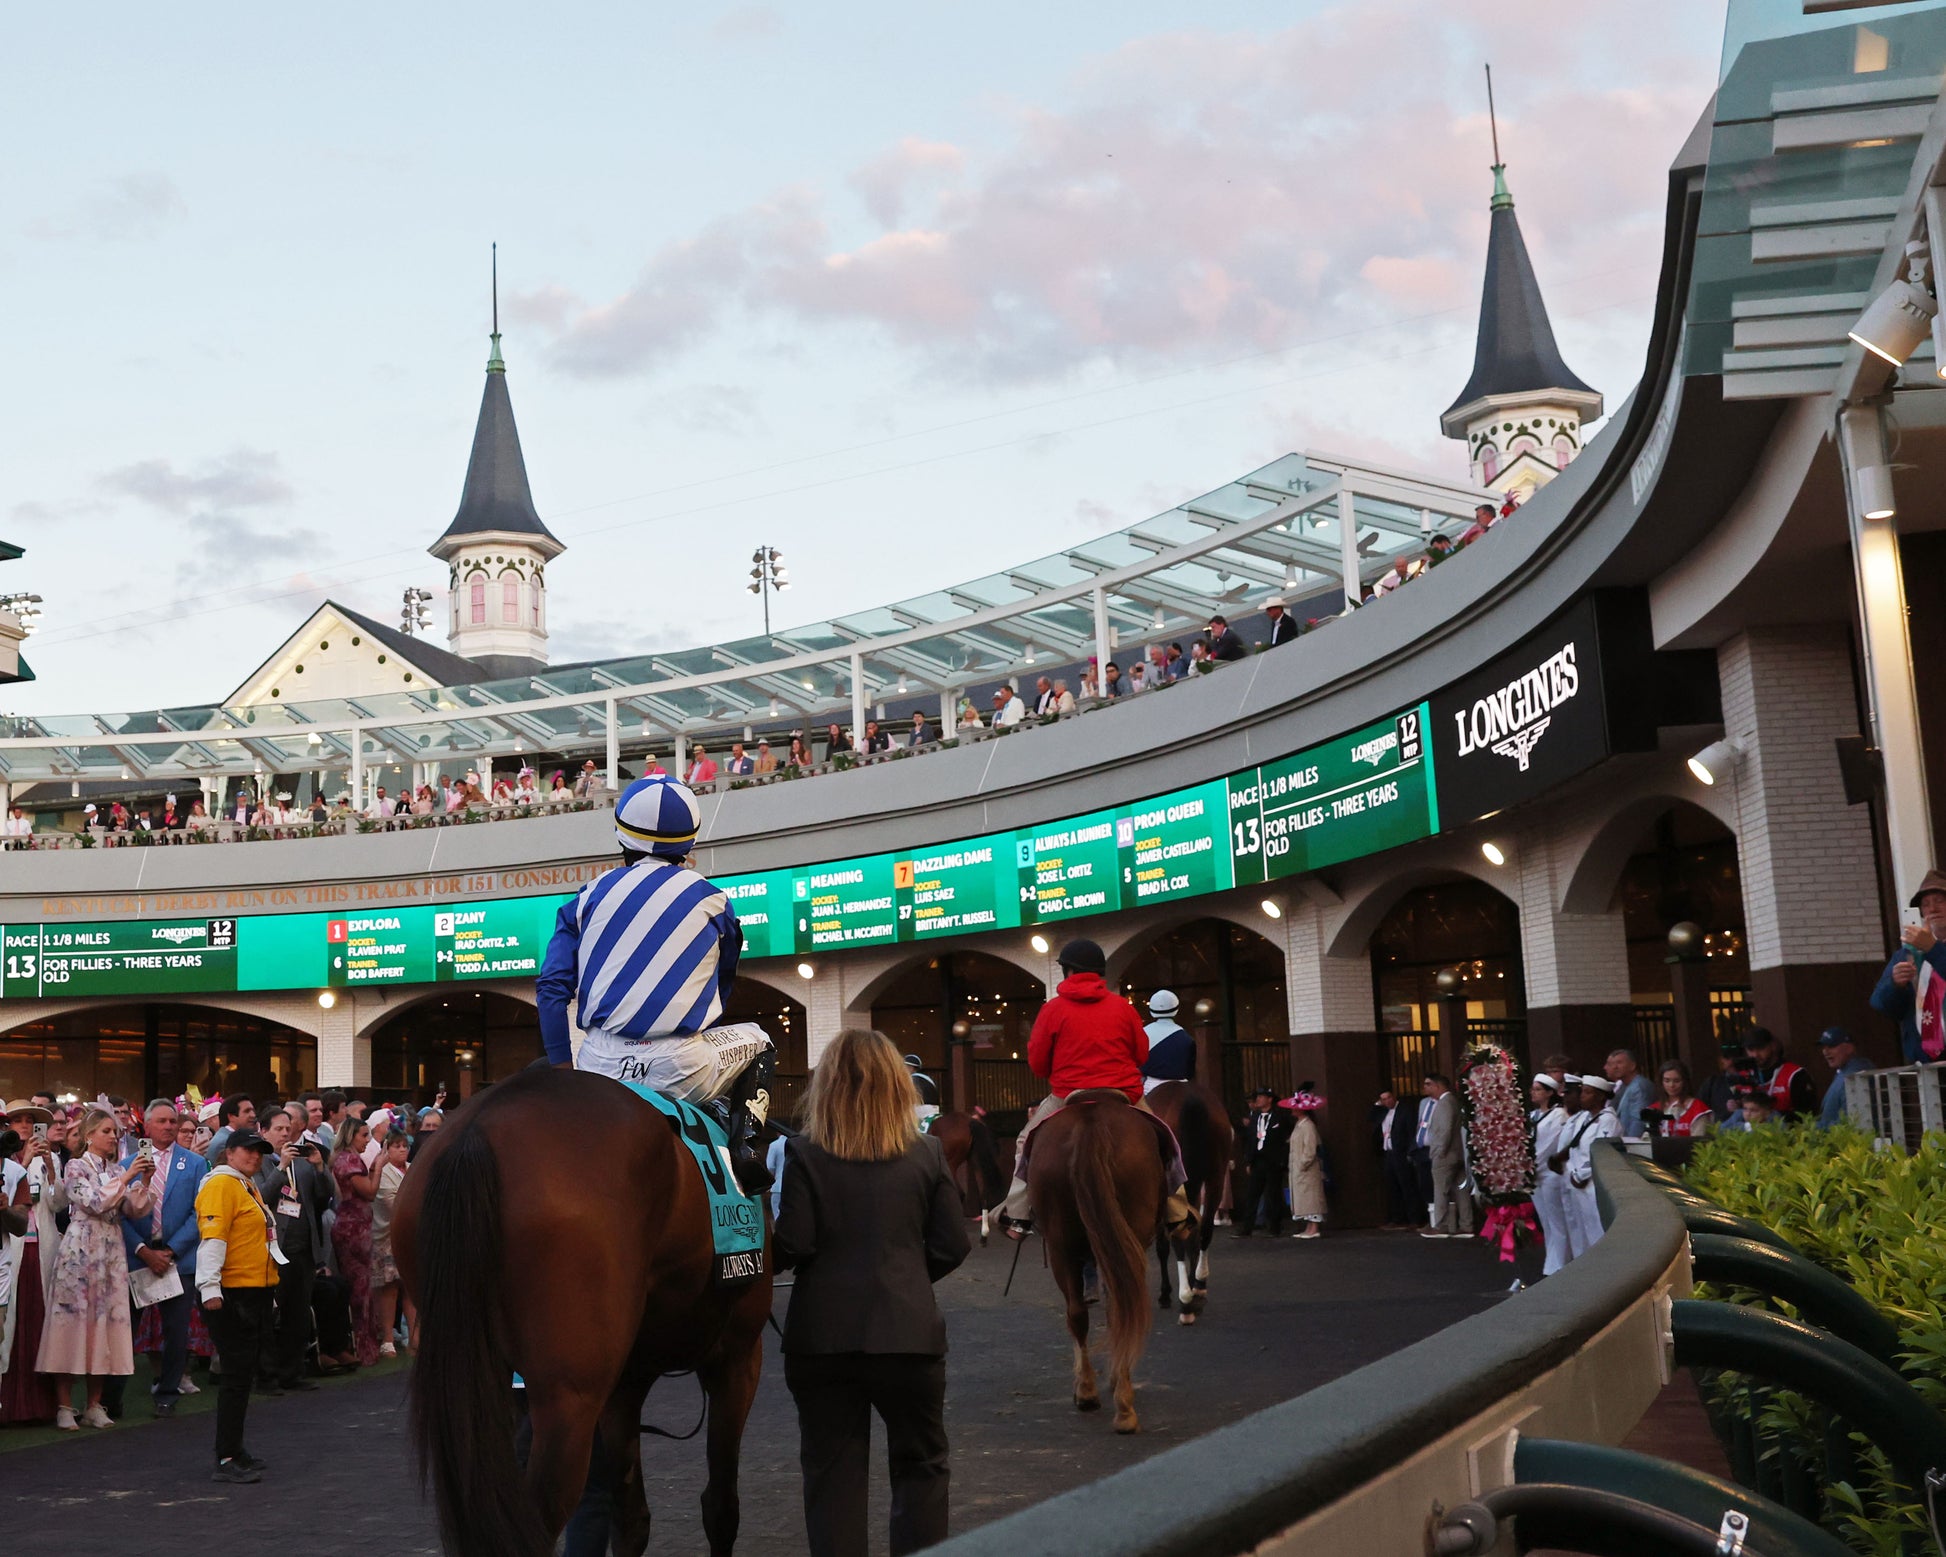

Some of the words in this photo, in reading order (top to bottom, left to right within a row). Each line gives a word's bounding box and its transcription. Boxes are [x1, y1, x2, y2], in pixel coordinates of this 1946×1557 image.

[1455, 642, 1578, 756] LONGINES
[1400, 714, 1418, 743] 12
[1351, 732, 1398, 763] LONGINES
[1404, 742, 1418, 759] MTP
[1262, 782, 1270, 799] 1
[1271, 778, 1287, 796] 1/8
[1288, 766, 1319, 791] MILES
[1230, 786, 1258, 810] RACE
[1134, 810, 1166, 831] PROM
[1167, 799, 1204, 822] QUEEN
[1265, 820, 1288, 839] FOR
[1288, 806, 1324, 832] FILLIES
[1331, 796, 1366, 820] THREE
[1366, 782, 1398, 808] YEARS
[1035, 832, 1070, 852] ALWAYS
[1070, 831, 1077, 845] A
[1077, 823, 1112, 843] RUNNER
[1118, 822, 1132, 842] 10
[1234, 818, 1260, 856] 13
[1136, 836, 1162, 851] JOCKEY:
[1136, 848, 1163, 865] JAVIER
[1163, 836, 1212, 859] CASTELLANO
[1266, 836, 1290, 858] OLD
[914, 853, 962, 874] DAZZLING
[964, 848, 992, 866] DAME
[1022, 846, 1029, 861] 9
[1036, 858, 1063, 872] JOCKEY:
[810, 870, 863, 889] MEANING
[900, 867, 907, 882] 7
[1037, 869, 1058, 884] JOSE
[1059, 868, 1066, 880] L.
[1067, 863, 1092, 879] ORTIZ
[1124, 867, 1132, 883] 5
[1136, 868, 1165, 882] TRAINER:
[738, 883, 767, 898] STARS
[796, 881, 806, 898] 5
[914, 880, 941, 892] JOCKEY:
[1138, 880, 1160, 897] BRAD
[1161, 879, 1170, 892] H.
[1170, 874, 1190, 890] COX
[42, 896, 148, 915] KENTUCKY
[154, 892, 220, 912] DERBY
[226, 890, 264, 908] RUN
[270, 888, 298, 906] ON
[304, 885, 349, 904] THIS
[356, 881, 418, 900] TRACK
[424, 878, 460, 896] FOR
[466, 874, 494, 891] 151
[811, 894, 838, 906] JOCKEY:
[914, 890, 933, 904] LUIS
[934, 888, 955, 901] SAEZ
[1020, 885, 1036, 902] 9-2
[1037, 887, 1066, 900] TRAINER:
[811, 905, 834, 917] JUAN
[835, 904, 842, 914] J.
[843, 897, 892, 913] HERNANDEZ
[1038, 899, 1063, 914] CHAD
[1064, 898, 1073, 909] C.
[1073, 892, 1105, 908] BROWN
[455, 912, 486, 924] ZANY
[899, 905, 912, 919] 37
[914, 906, 944, 918] TRAINER:
[212, 921, 232, 936] 12
[348, 918, 400, 932] EXPLORA
[441, 918, 448, 931] 2
[799, 918, 806, 932] 8
[811, 920, 841, 931] TRAINER:
[916, 916, 952, 932] BRITTANY
[962, 910, 996, 925] RUSSELL
[152, 927, 206, 939] LONGINES
[334, 924, 341, 938] 1
[455, 931, 482, 940] JOCKEY:
[813, 930, 844, 944] MICHAEL
[844, 929, 853, 940] W.
[854, 924, 893, 939] MCCARTHY
[6, 935, 38, 947] RACE
[44, 935, 50, 946] 1
[53, 934, 72, 946] 1/8
[75, 933, 110, 945] MILES
[213, 936, 231, 945] MTP
[348, 938, 376, 946] JOCKEY:
[455, 940, 475, 950] IRAD
[477, 938, 505, 948] ORTIZ,
[506, 936, 519, 946] JR.
[348, 946, 383, 956] FLAVIEN
[384, 944, 406, 954] PRAT
[437, 950, 453, 962] 9-2
[455, 953, 484, 962] TRAINER:
[6, 955, 36, 978] 13
[44, 959, 68, 971] FOR
[71, 958, 112, 970] FILLIES
[123, 956, 162, 968] THREE
[165, 955, 202, 967] YEARS
[334, 956, 341, 968] 6
[347, 960, 378, 968] TRAINER:
[455, 963, 480, 973] TODD
[482, 962, 490, 972] A.
[492, 959, 536, 971] PLETCHER
[43, 971, 70, 983] OLD
[348, 969, 367, 979] BOB
[368, 967, 405, 978] BAFFERT
[705, 1028, 744, 1047] HORSE
[655, 1091, 726, 1194] 9
[722, 1253, 755, 1279] ALWAYS
